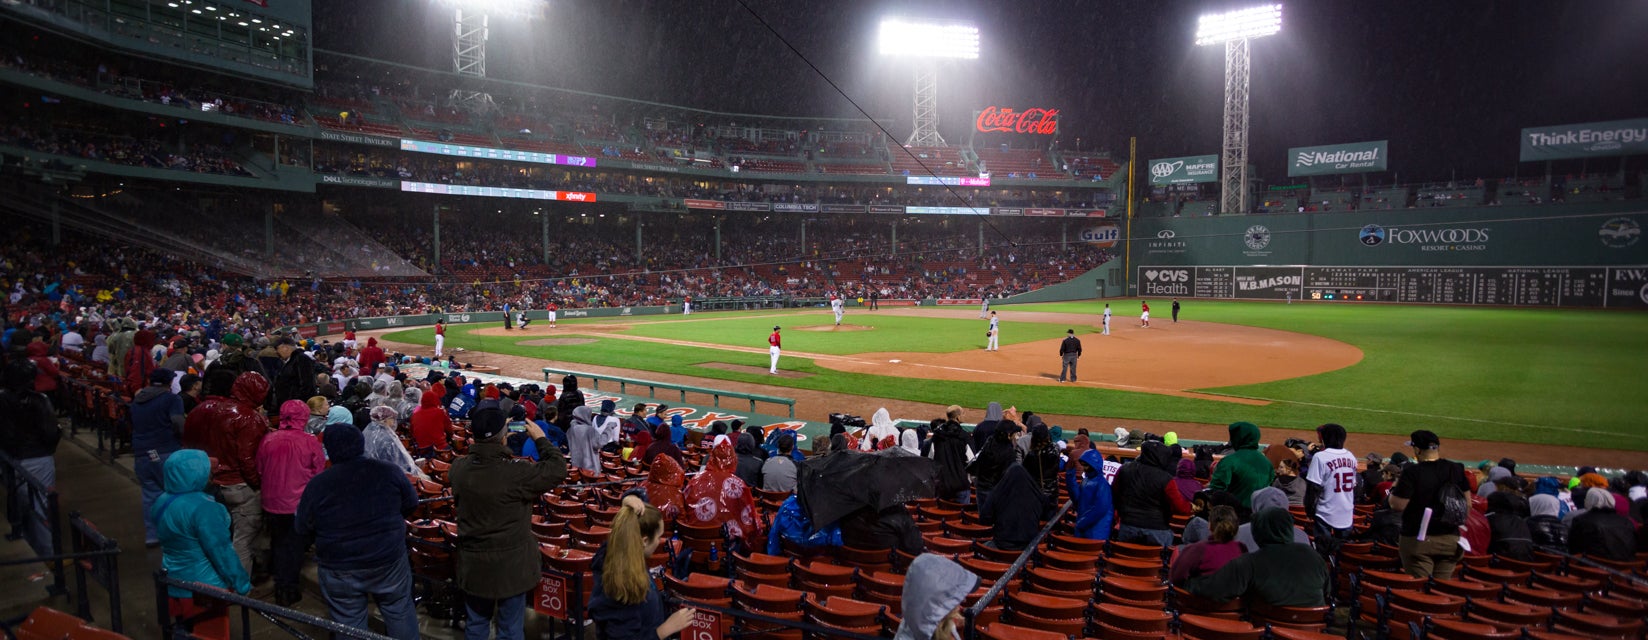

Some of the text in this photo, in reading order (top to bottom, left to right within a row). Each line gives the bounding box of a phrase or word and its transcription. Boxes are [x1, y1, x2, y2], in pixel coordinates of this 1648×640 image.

[976, 106, 1059, 134] Coca-Cola
[1314, 148, 1378, 164] National
[323, 175, 342, 183] DELL
[566, 193, 587, 202] xfinity
[1082, 229, 1118, 241] Gulf
[1388, 227, 1489, 244] FOXWOODS
[1159, 269, 1189, 281] CVS
[1146, 282, 1188, 294] Health
[1612, 288, 1634, 296] Since
[1103, 464, 1118, 474] ETTS
[1333, 472, 1354, 493] 15
[543, 585, 558, 594] BOX
[541, 594, 562, 611] 20
[694, 612, 716, 623] IELD
[692, 619, 713, 631] BOX
